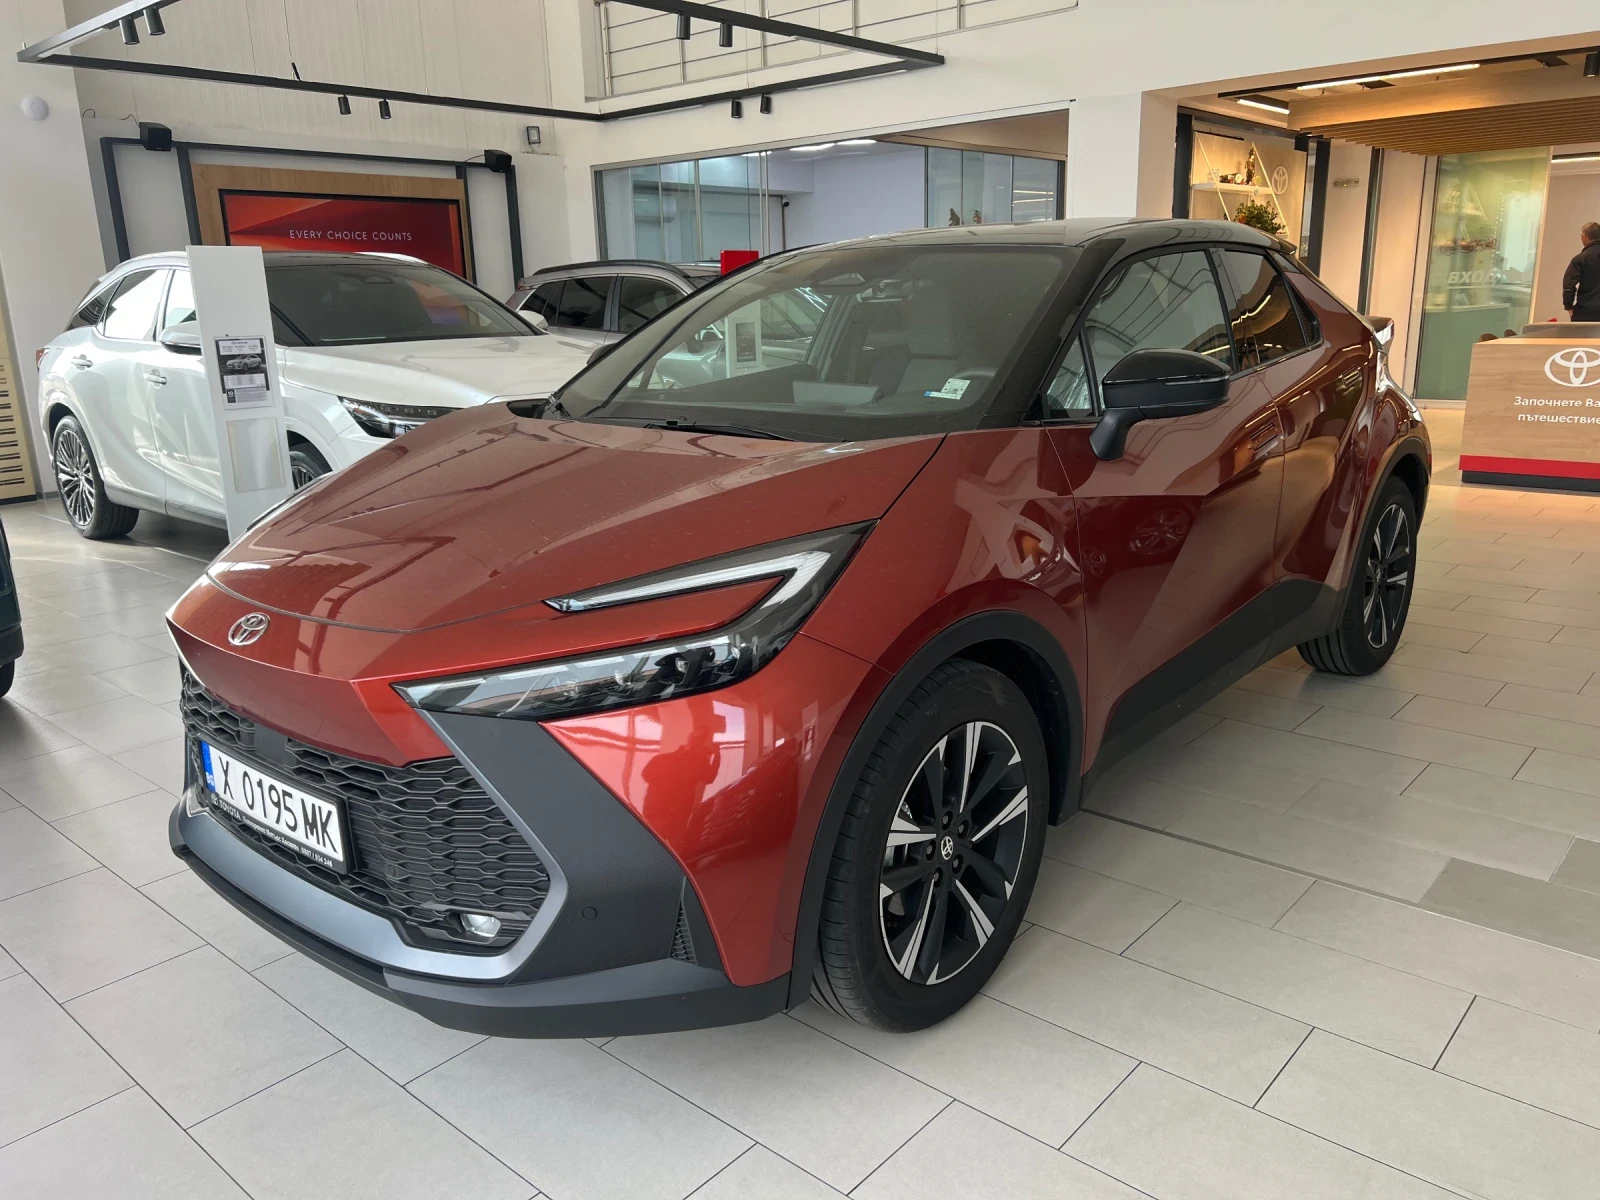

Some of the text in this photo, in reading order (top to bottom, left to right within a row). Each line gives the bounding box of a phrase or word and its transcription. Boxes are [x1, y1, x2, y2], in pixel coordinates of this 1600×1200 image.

[289, 229, 412, 241] EVERY CHOICE COUNTS
[1513, 396, 1583, 407] Започнете
[242, 770, 298, 833] 0195
